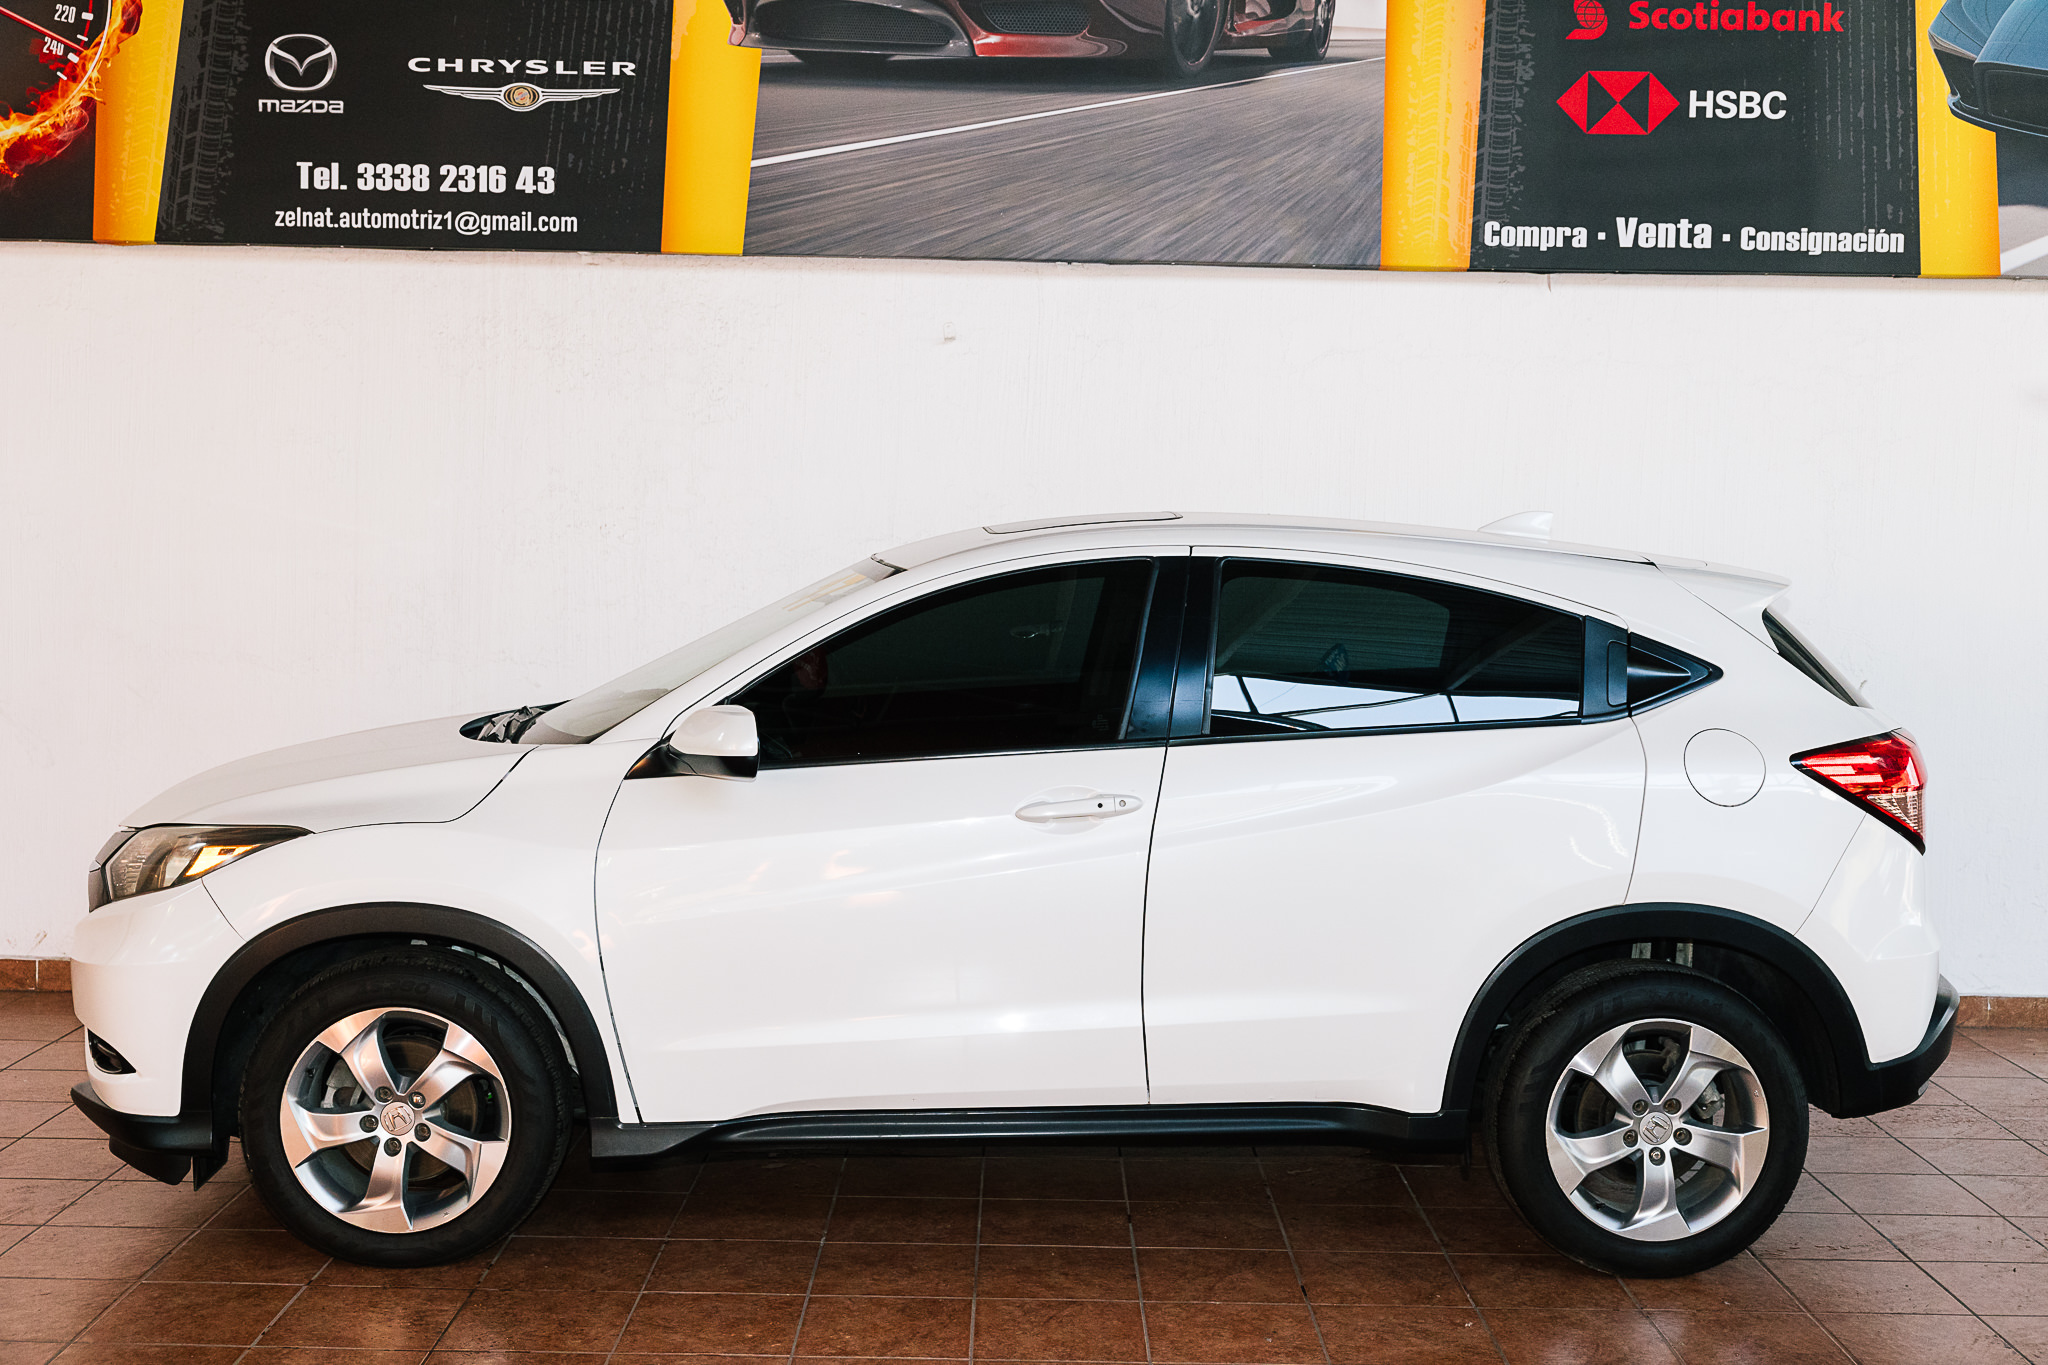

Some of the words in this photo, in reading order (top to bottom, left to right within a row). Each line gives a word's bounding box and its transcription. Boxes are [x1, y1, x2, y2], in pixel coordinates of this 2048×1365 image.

[54, 4, 76, 23] 220
[1628, 0, 1845, 32] Scotiabank
[42, 36, 64, 56] 240
[407, 57, 637, 76] CHRYSLER
[1688, 90, 1787, 120] HSBC
[297, 161, 348, 190] Tel.
[357, 162, 430, 192] 3338
[439, 164, 507, 194] 2316
[515, 165, 556, 195] 43
[274, 206, 578, 236] zelnat.automotriz1@gmail.com
[1483, 220, 1588, 252] Compra
[1615, 216, 1713, 249] Venta
[1740, 226, 1905, 255] Consignación
